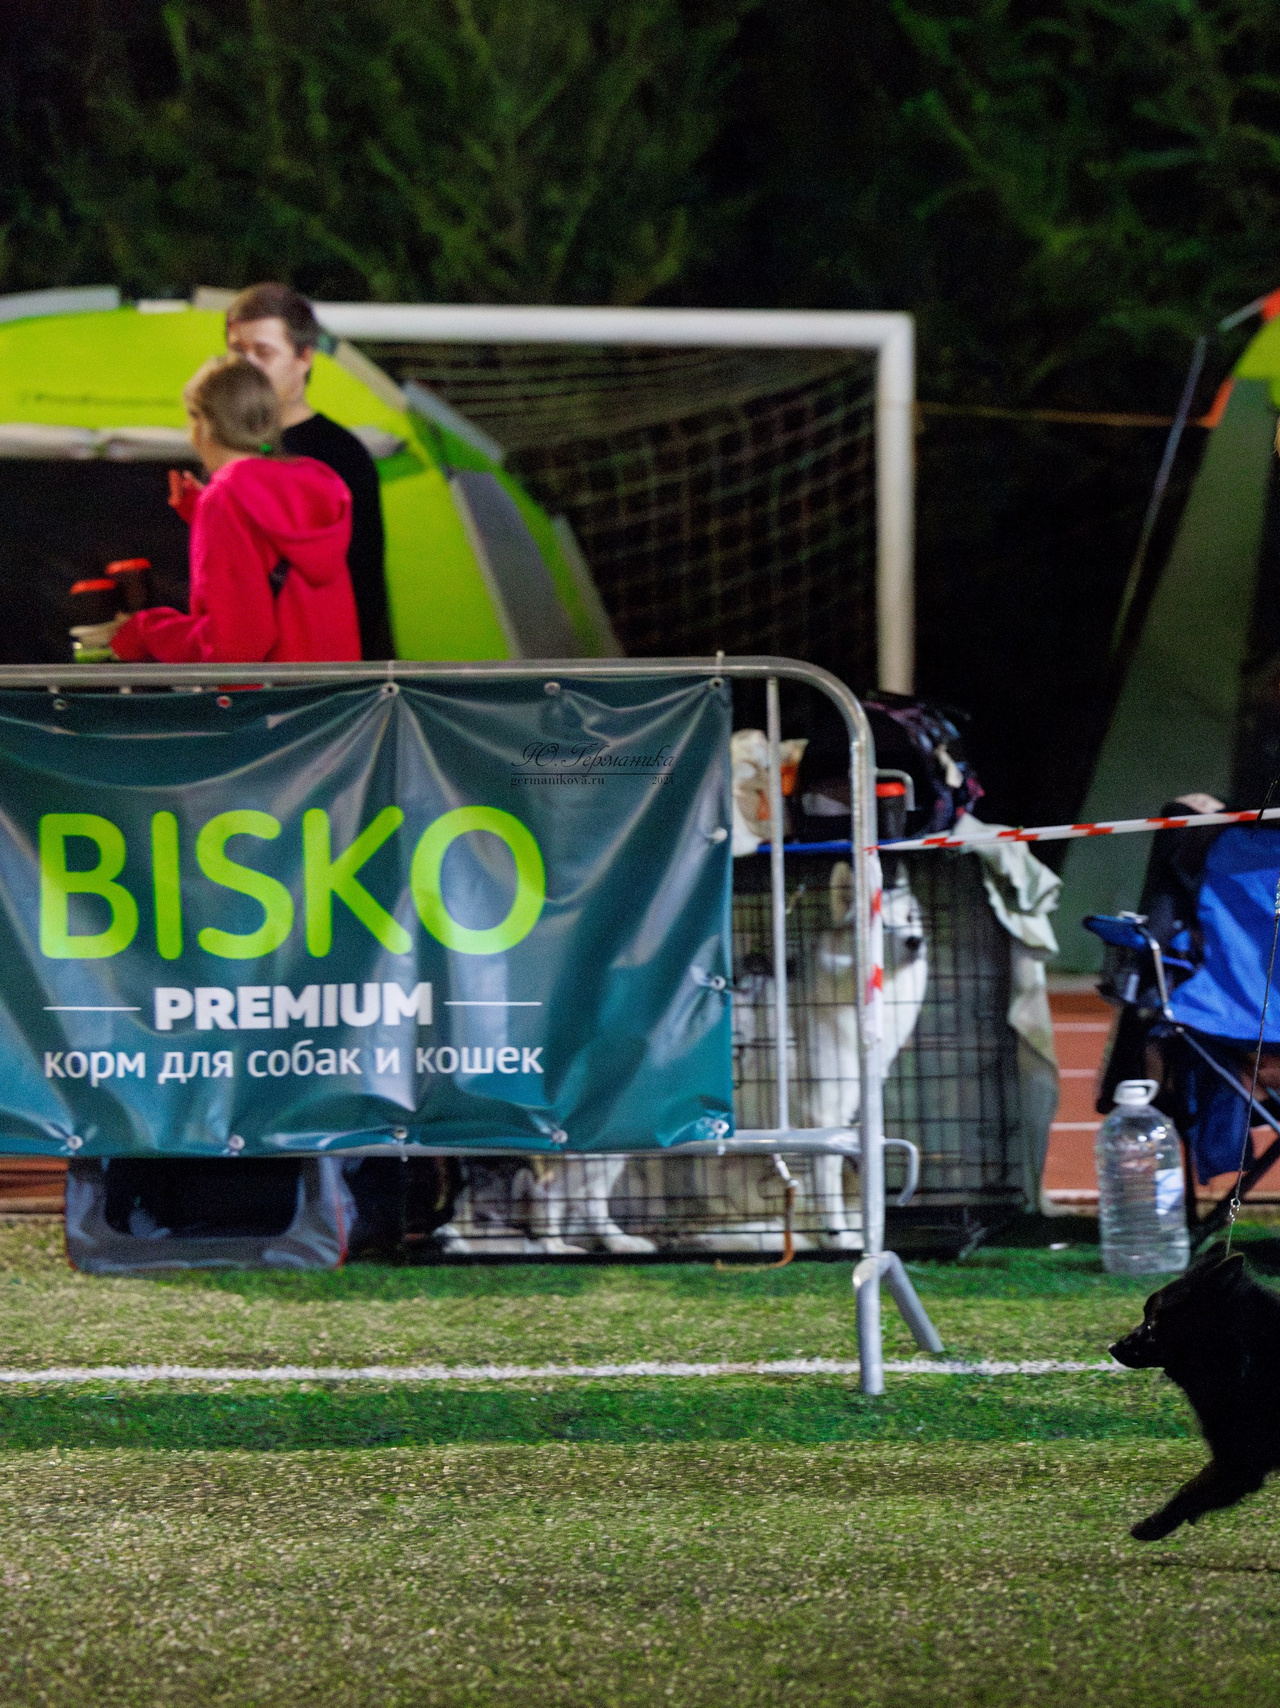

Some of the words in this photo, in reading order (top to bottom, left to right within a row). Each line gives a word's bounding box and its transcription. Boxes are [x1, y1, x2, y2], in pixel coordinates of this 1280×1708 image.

[38, 805, 546, 960] BISKO
[153, 981, 433, 1031] PREMIUM
[44, 1049, 147, 1088] корм
[157, 1049, 234, 1085] для
[247, 1039, 362, 1078] собак
[375, 1046, 401, 1075] и
[415, 1044, 545, 1076] кошек
